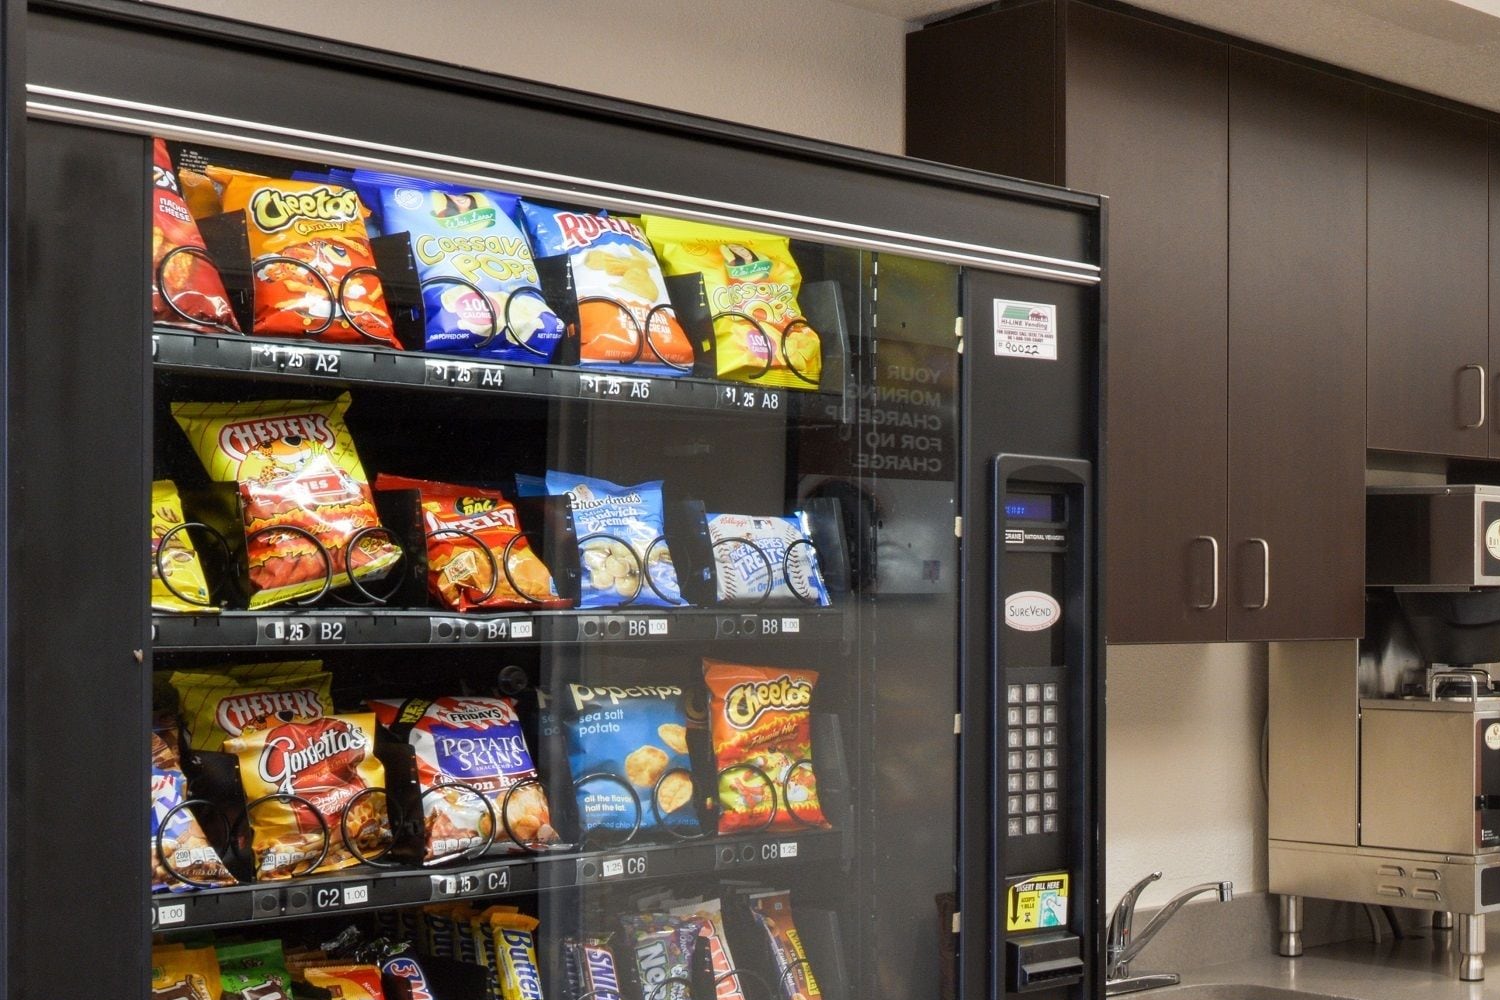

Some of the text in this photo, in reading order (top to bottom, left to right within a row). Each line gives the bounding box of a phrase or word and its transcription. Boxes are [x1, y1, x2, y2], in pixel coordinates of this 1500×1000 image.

[159, 198, 188, 213] NACHO
[159, 205, 191, 222] CHEESE
[252, 188, 357, 230] Cheetos
[315, 353, 339, 373] A2
[482, 369, 503, 386] A4
[630, 381, 650, 399] A6
[761, 392, 779, 410] A8
[220, 413, 336, 460] CHESTER'S
[463, 501, 493, 517] BAG
[320, 622, 343, 640] B2
[487, 624, 531, 639] B4 1.00
[629, 620, 666, 636] B6 1.00
[762, 618, 798, 634] B8 1.00
[570, 684, 683, 711] popchips
[727, 675, 812, 726] Cheetos
[450, 708, 502, 722] FRIDAYS
[579, 709, 624, 723] sea salt
[578, 723, 621, 737] potato
[442, 736, 527, 757] POTATO
[259, 723, 367, 796] Gardetto's
[459, 750, 523, 771] SKINS
[761, 843, 778, 860] C8
[627, 857, 646, 874] C6
[488, 872, 508, 890] C4
[1047, 881, 1061, 889] HERE
[317, 888, 367, 908] C2 1.00
[160, 906, 184, 920] 1.00
[391, 963, 420, 977] 3
